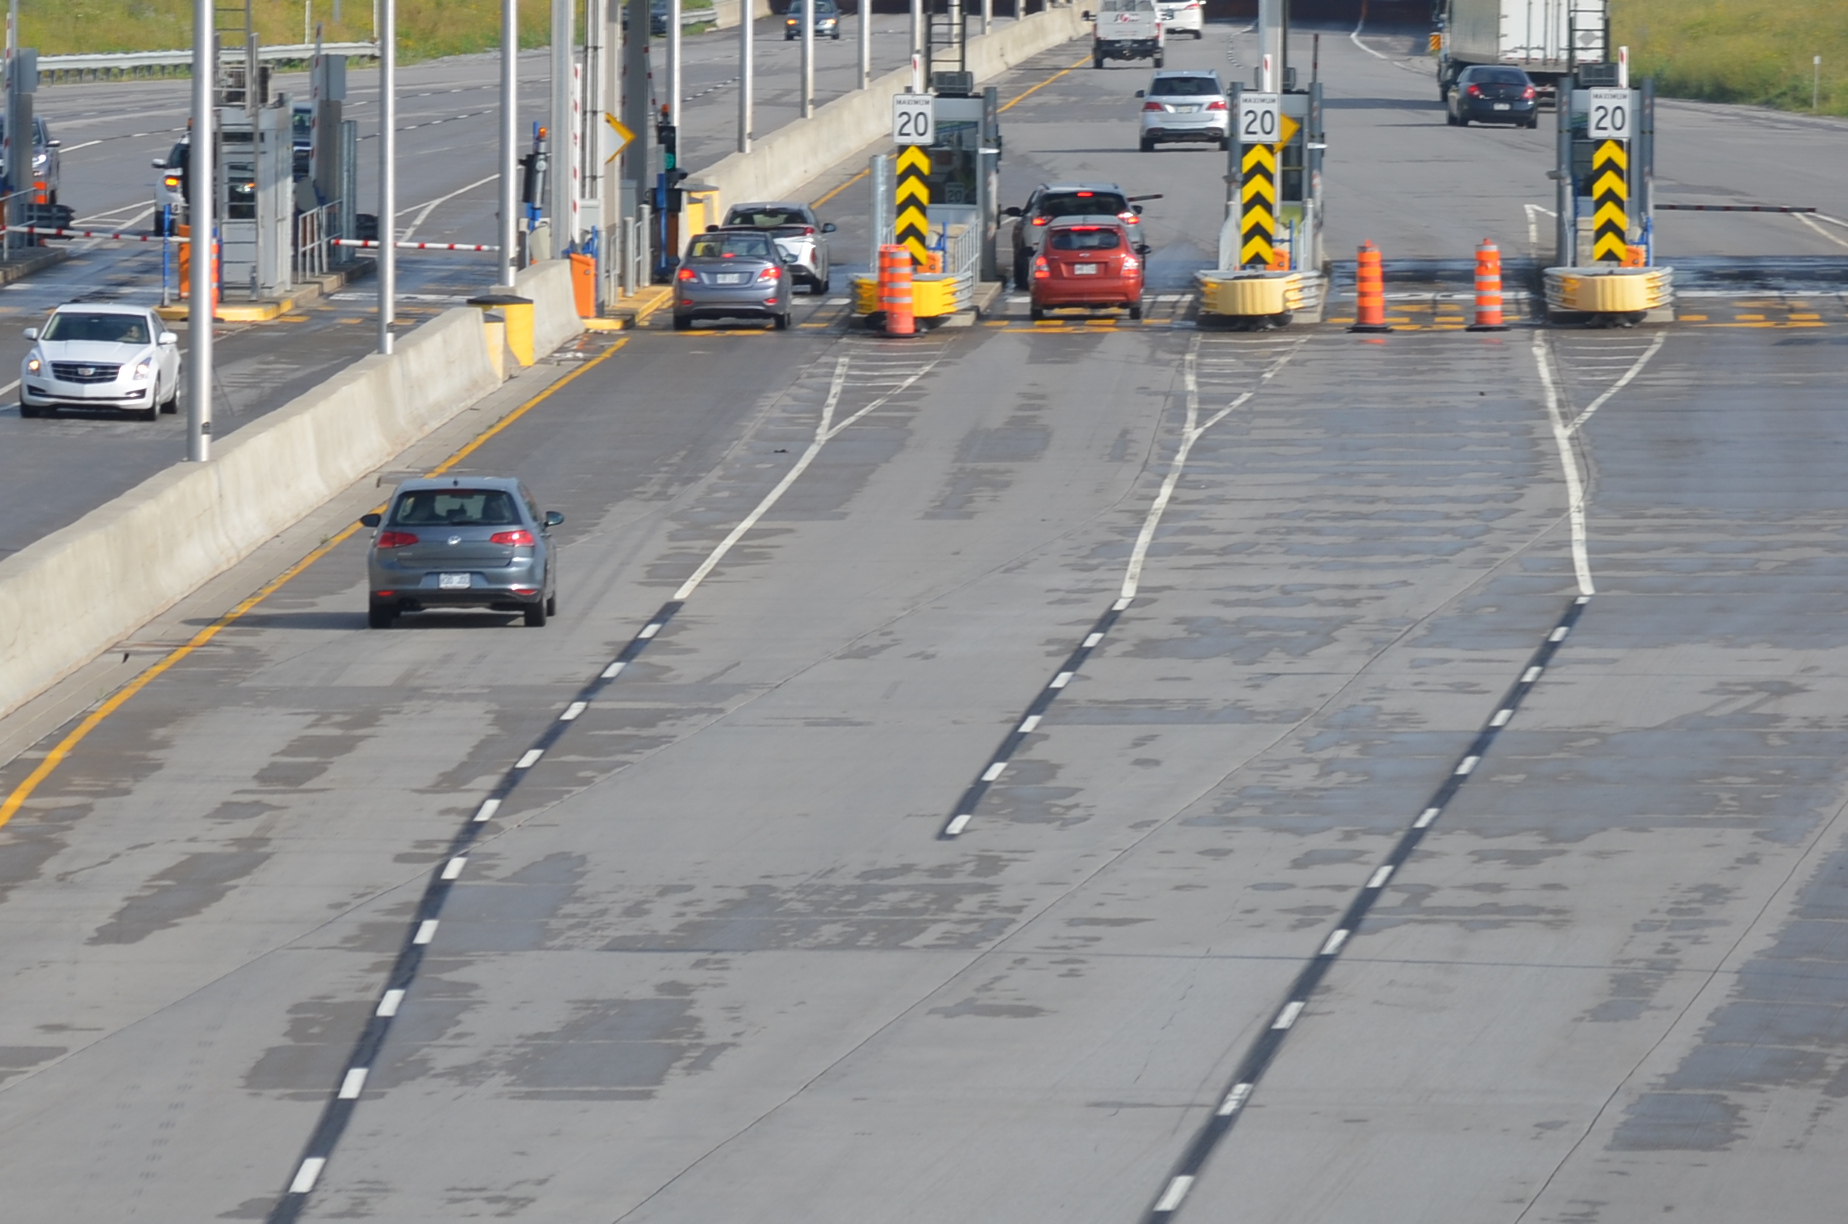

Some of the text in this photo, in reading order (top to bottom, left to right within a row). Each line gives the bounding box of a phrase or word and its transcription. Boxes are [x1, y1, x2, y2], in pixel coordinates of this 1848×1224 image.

[897, 111, 929, 137] 20
[1243, 109, 1275, 135] 20
[1594, 105, 1626, 131] 20
